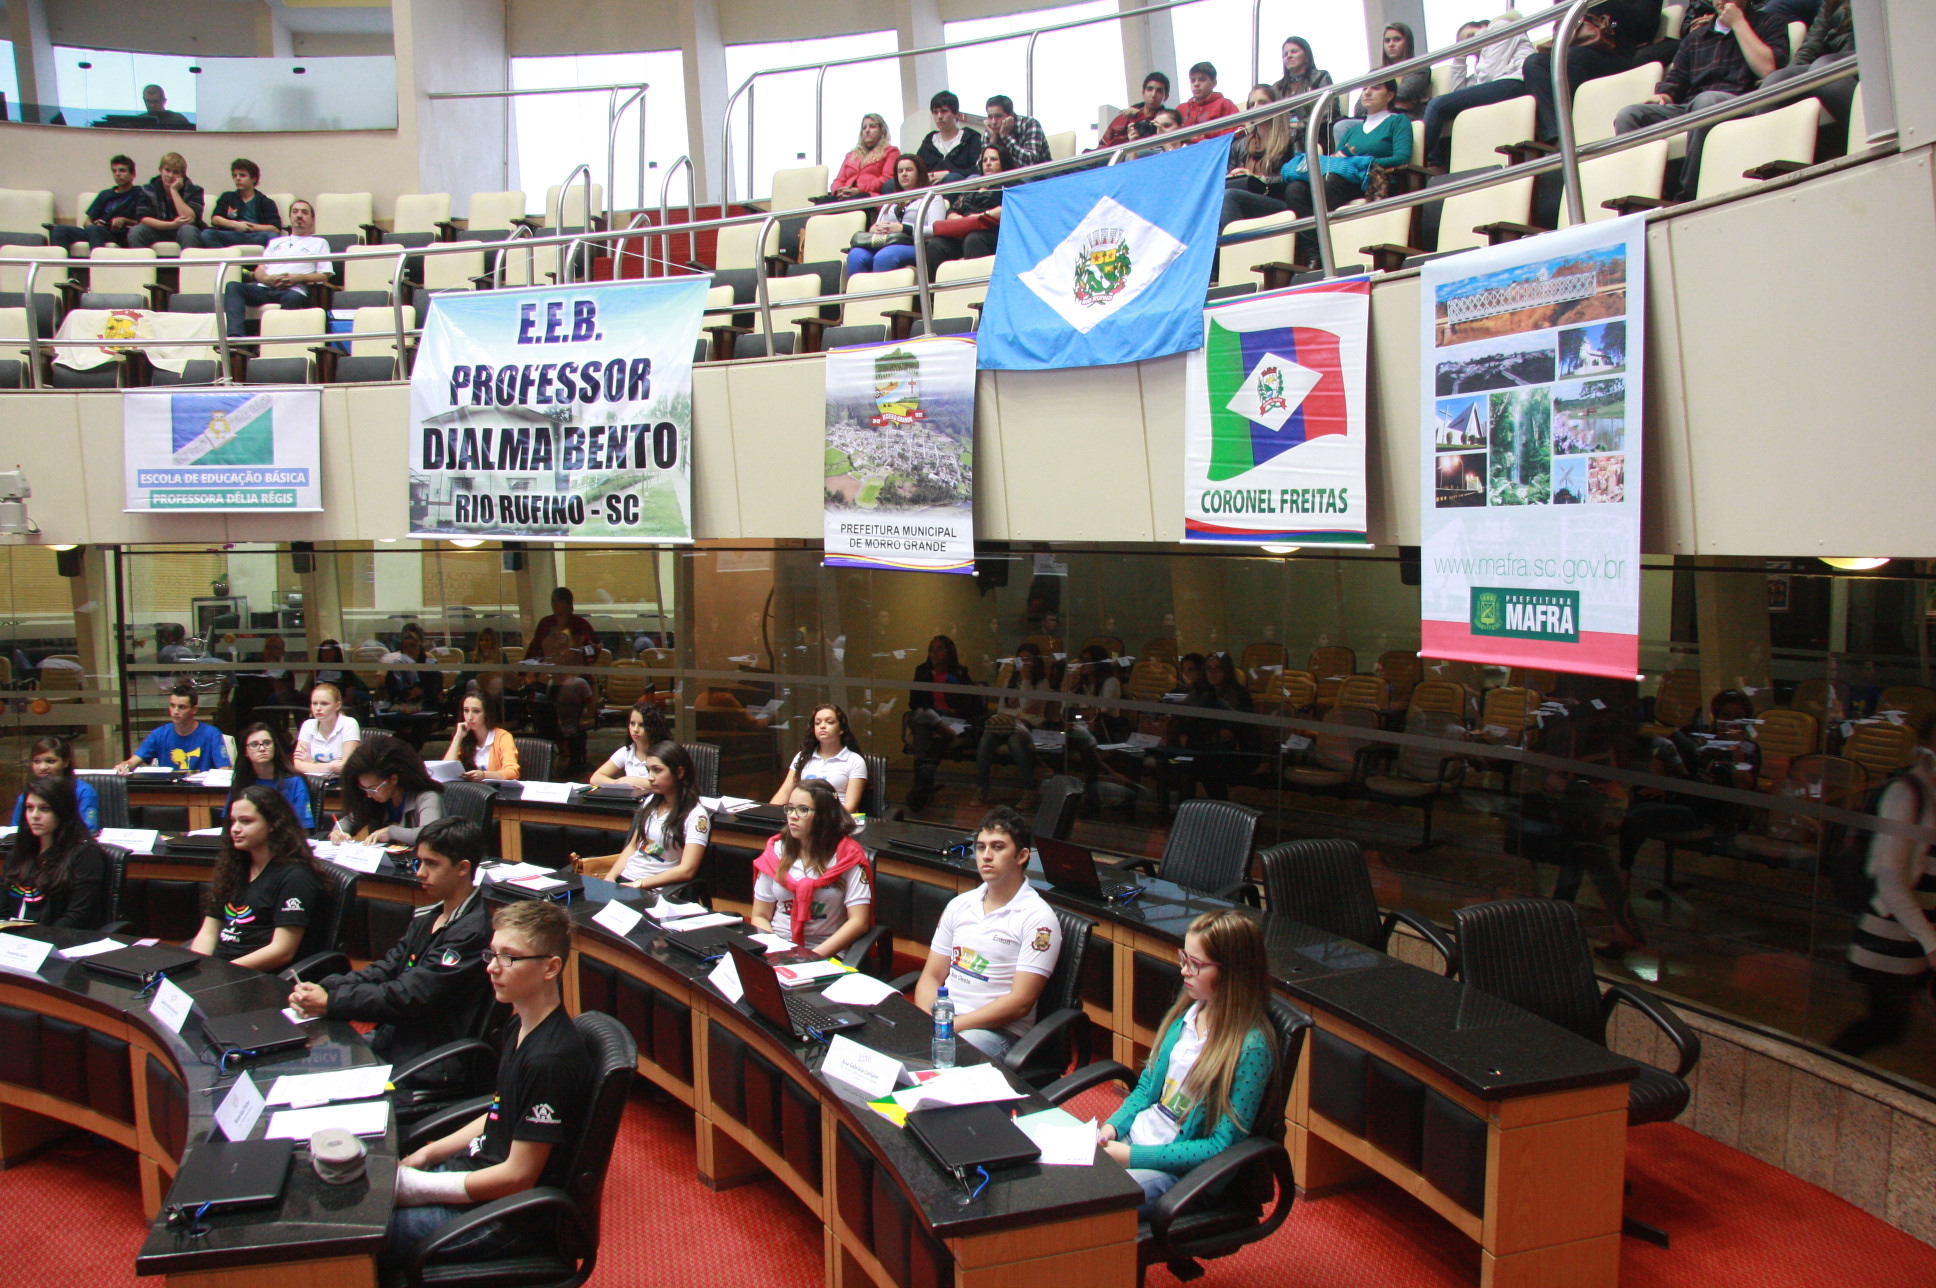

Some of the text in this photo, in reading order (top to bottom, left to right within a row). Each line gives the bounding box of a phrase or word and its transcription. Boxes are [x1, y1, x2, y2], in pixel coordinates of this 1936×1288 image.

[517, 300, 603, 345] E.E.B.
[450, 357, 651, 406] PROFESSOR
[422, 421, 678, 471] DJALMA BENTO
[140, 470, 306, 486] ESCOLA DE EDUCAÇÃO BÁSICA
[153, 490, 293, 505] PROFESSORA DÉLIA RÉGIS
[455, 494, 495, 524] RIO
[500, 494, 585, 526] RUFINO
[606, 493, 640, 526] SC
[1201, 488, 1348, 514] CORONEL FREITAS
[840, 523, 957, 538] PREFEITURA MUNICIPAL
[849, 538, 947, 552] DE MORRO GRANDE
[1433, 552, 1625, 584] www.mafra.sc.gov.br
[1505, 595, 1572, 605] PREFEITURA
[1505, 603, 1575, 635] MAFRA
